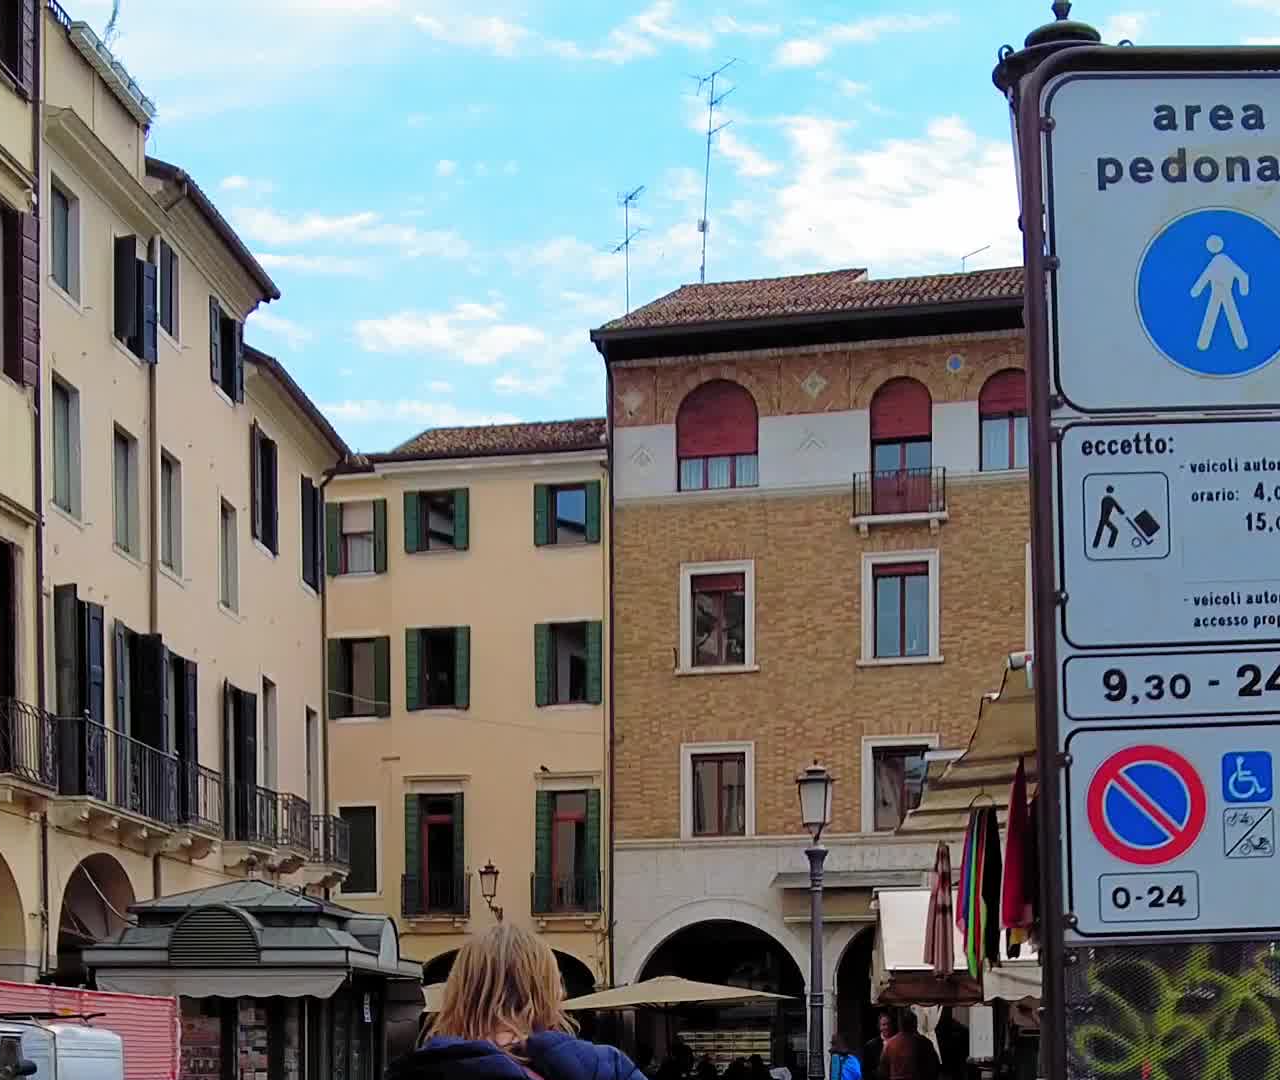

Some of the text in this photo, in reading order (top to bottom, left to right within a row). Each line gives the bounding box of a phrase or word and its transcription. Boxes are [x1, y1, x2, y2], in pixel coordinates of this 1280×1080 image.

[1153, 103, 1266, 132] area
[1081, 431, 1174, 457] eccetto:
[1189, 457, 1239, 474] veicoli
[1191, 487, 1239, 503] orario:
[1193, 591, 1241, 607] veicoli
[1193, 615, 1249, 628] accesso
[1102, 668, 1192, 705] 9,30
[1111, 884, 1187, 910] 0-24
